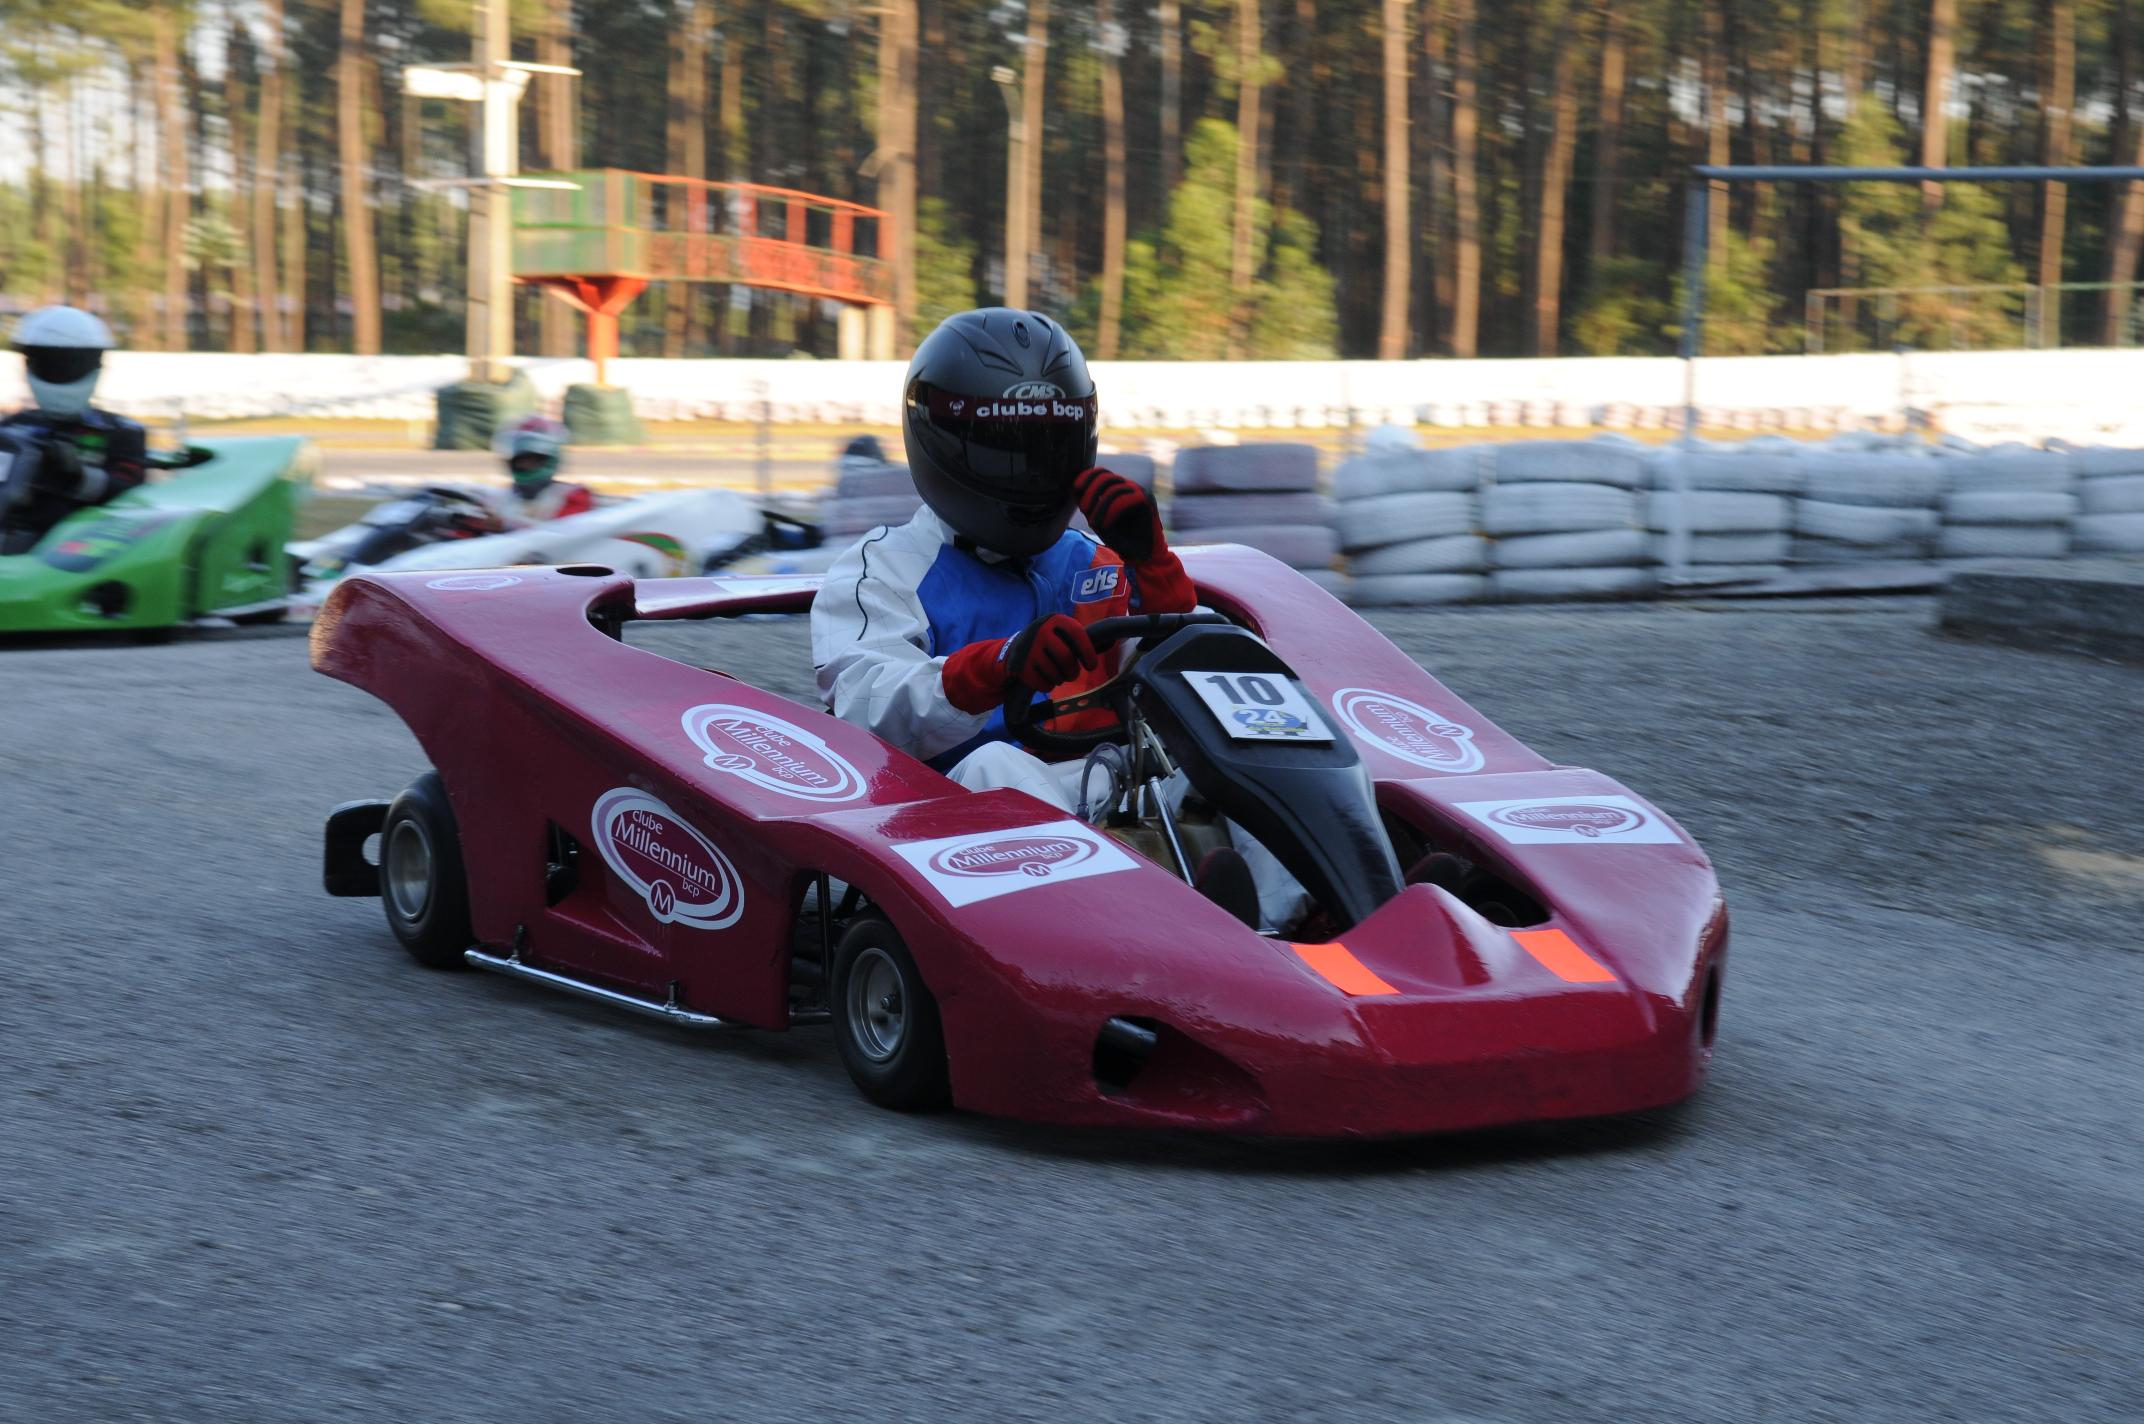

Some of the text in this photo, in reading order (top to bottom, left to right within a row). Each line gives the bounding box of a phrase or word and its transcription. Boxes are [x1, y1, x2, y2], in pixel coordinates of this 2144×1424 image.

[1016, 385, 1055, 399] CMS
[976, 400, 1084, 421] clube bcp
[1204, 675, 1285, 706] 10
[1238, 710, 1288, 725] 24
[755, 725, 792, 747] clube
[717, 719, 829, 785] Millennium
[771, 766, 794, 779] bcp
[632, 809, 663, 835] clube
[615, 813, 716, 890] Millennium
[950, 841, 1070, 869] Millennium
[682, 877, 700, 898] bcp
